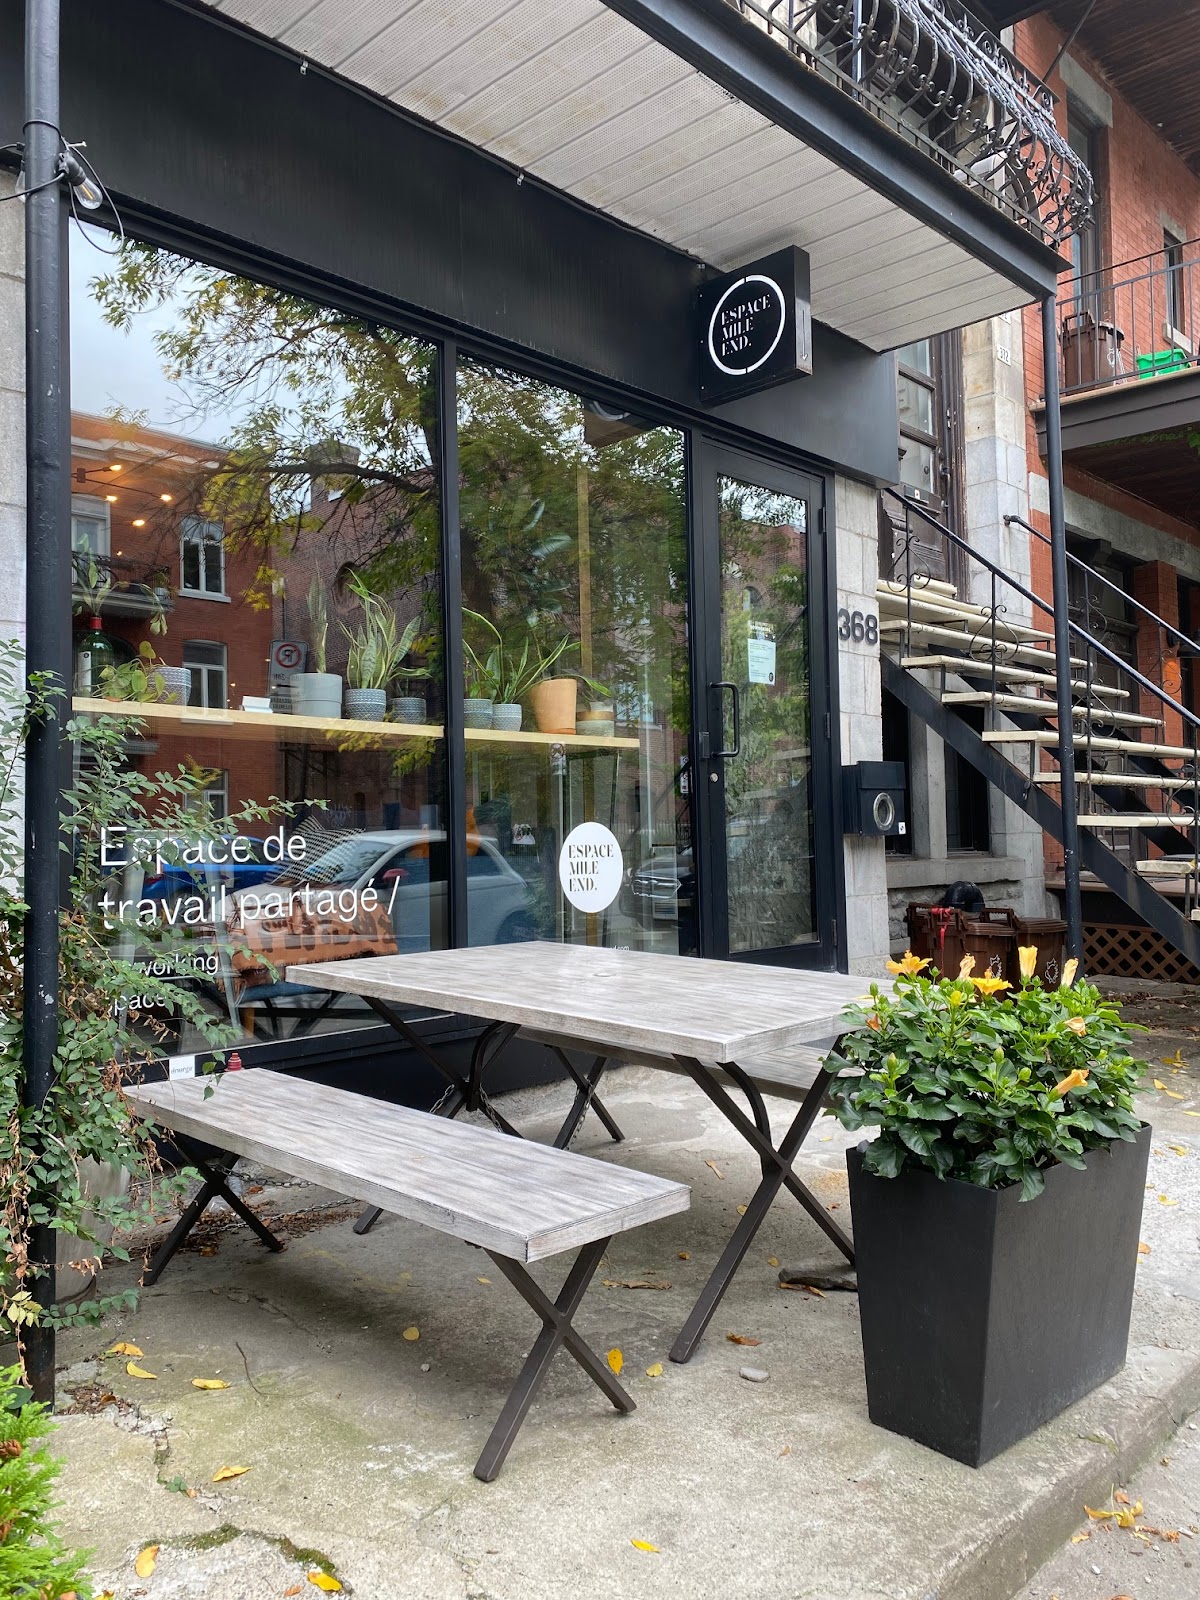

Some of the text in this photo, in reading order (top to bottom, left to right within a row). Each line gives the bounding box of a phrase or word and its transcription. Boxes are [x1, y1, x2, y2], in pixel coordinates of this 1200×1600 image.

[721, 294, 771, 326] ESPACE
[722, 316, 754, 341] MILE
[721, 335, 752, 357] END.
[838, 608, 878, 645] 368
[101, 825, 307, 874] Espace de
[568, 844, 614, 858] ESPACE
[569, 861, 599, 875] MILE
[569, 877, 598, 892] END.
[98, 884, 226, 929] travail
[239, 877, 378, 930] partagé
